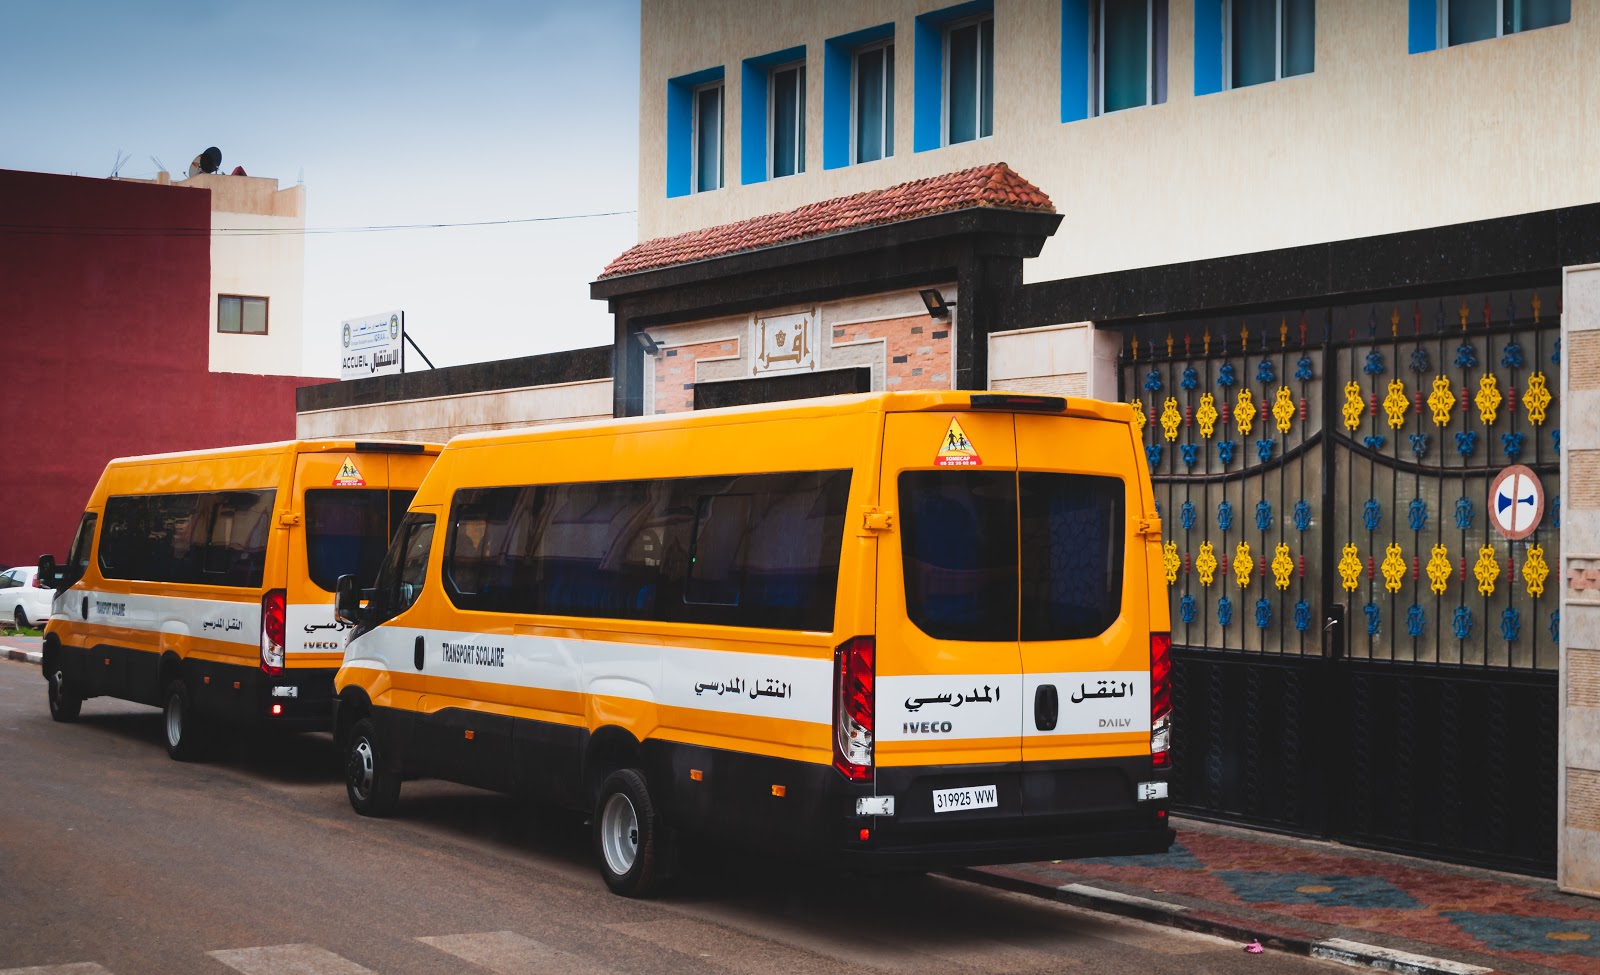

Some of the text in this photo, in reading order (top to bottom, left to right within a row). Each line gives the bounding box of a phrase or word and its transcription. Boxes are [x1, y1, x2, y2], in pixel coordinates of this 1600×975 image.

[343, 355, 368, 369] ACCUEIL
[370, 349, 399, 373] الاستقبال
[303, 641, 338, 649] IVECO
[442, 642, 505, 667] TRANSPORT SCOLAIRE
[694, 677, 792, 699] النقل المدرسي
[904, 680, 1134, 713] النقل المدرسي
[902, 720, 953, 734] IVECO
[937, 789, 995, 808] 319925 WW
